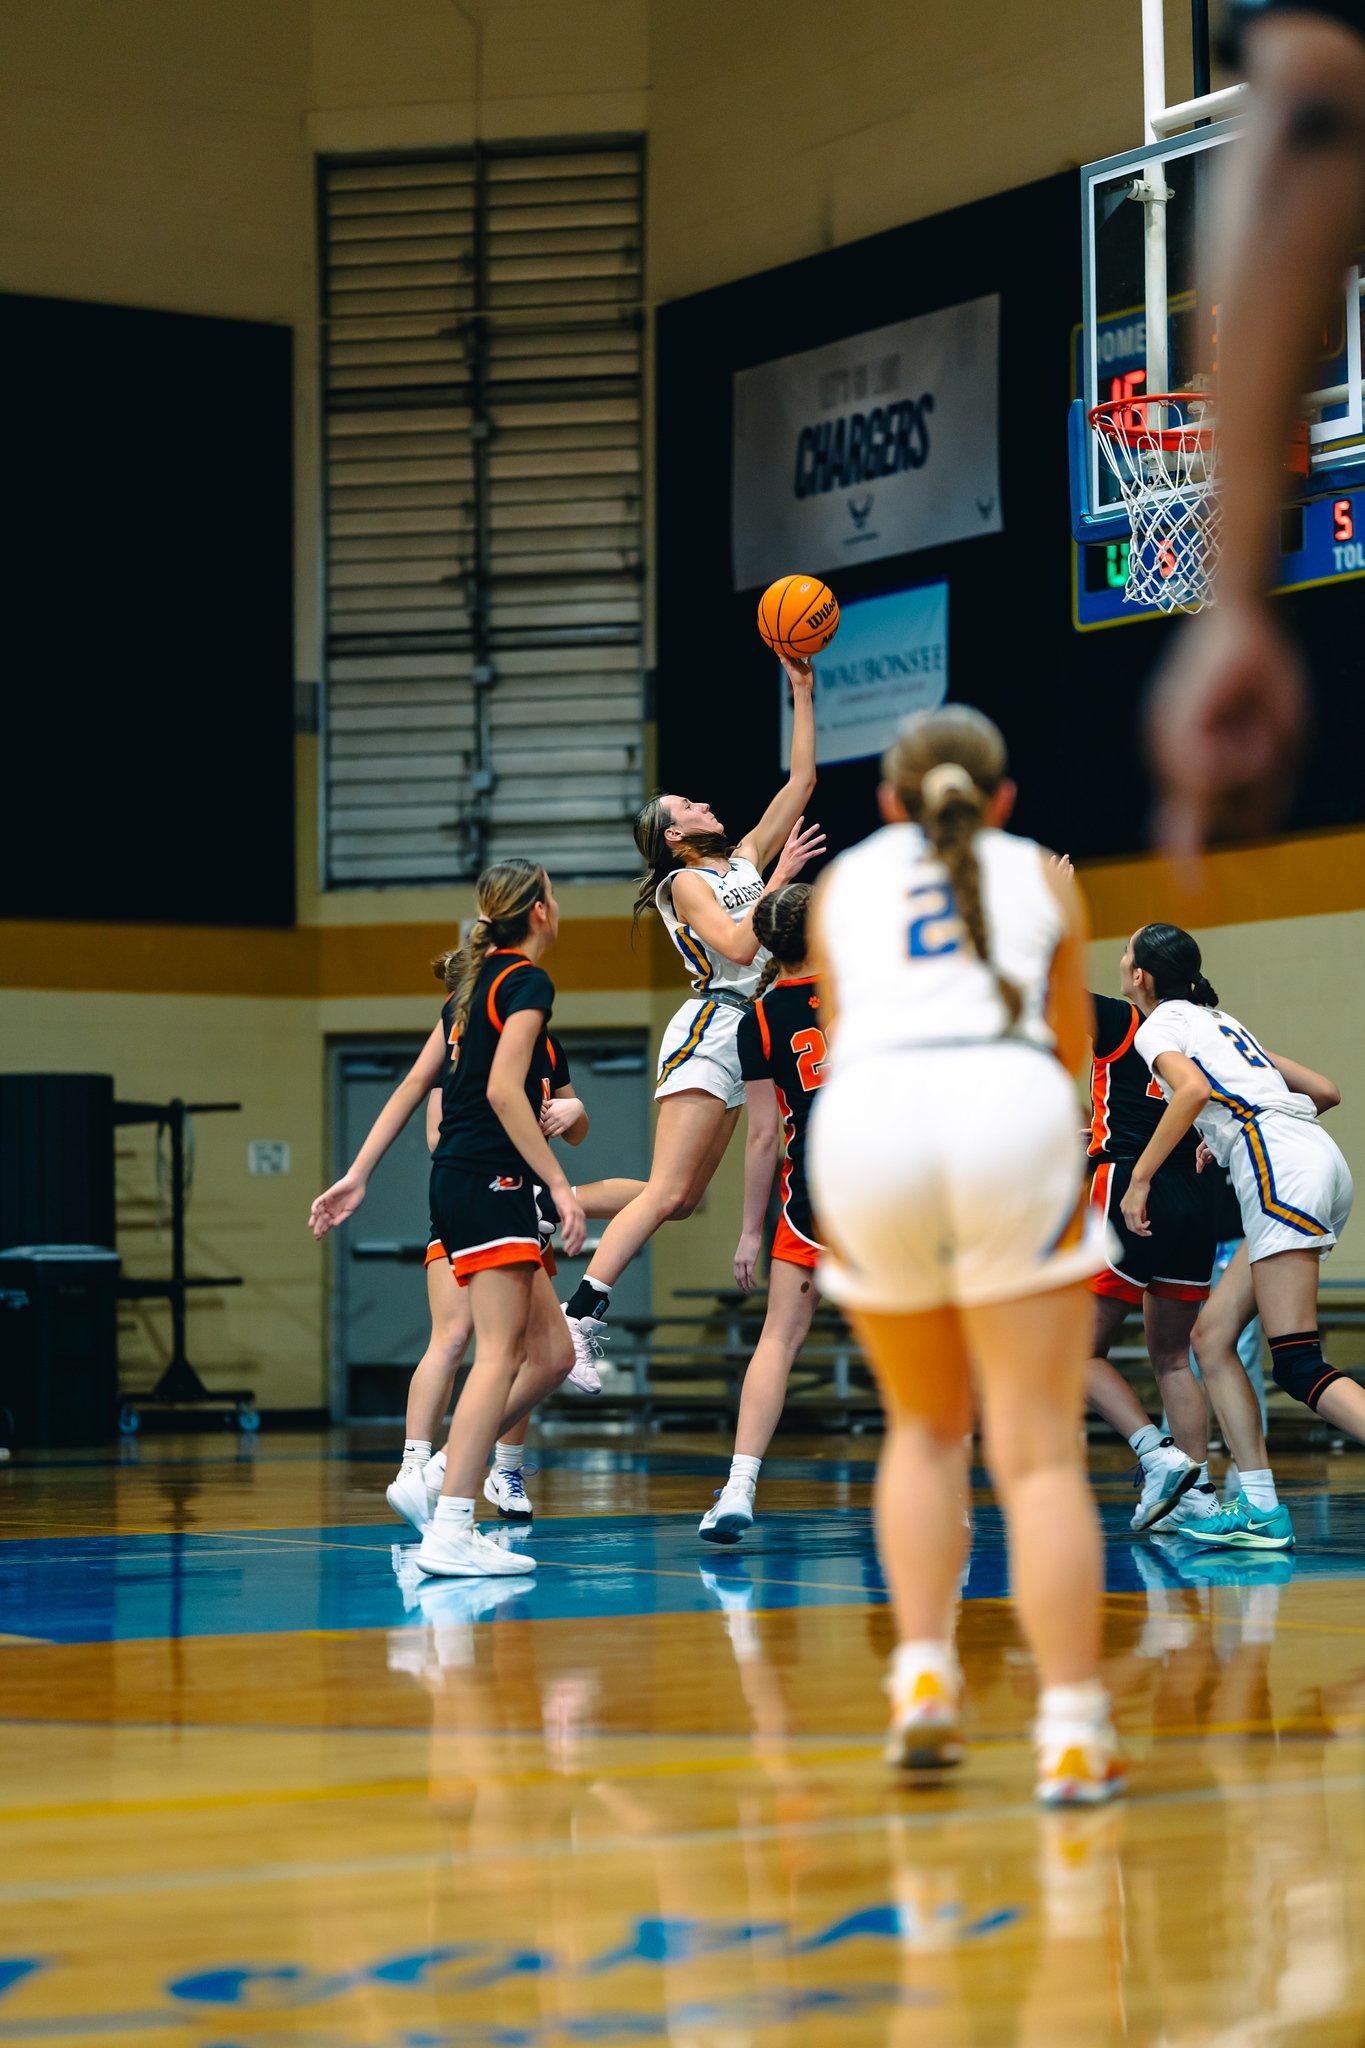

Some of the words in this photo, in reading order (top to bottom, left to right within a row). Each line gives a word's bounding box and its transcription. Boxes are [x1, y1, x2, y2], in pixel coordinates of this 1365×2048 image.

[1098, 323, 1147, 364] OME
[795, 392, 934, 500] CHARGERS
[1333, 500, 1353, 541] 5
[806, 594, 837, 630] Wilso
[790, 1026, 832, 1092] 2
